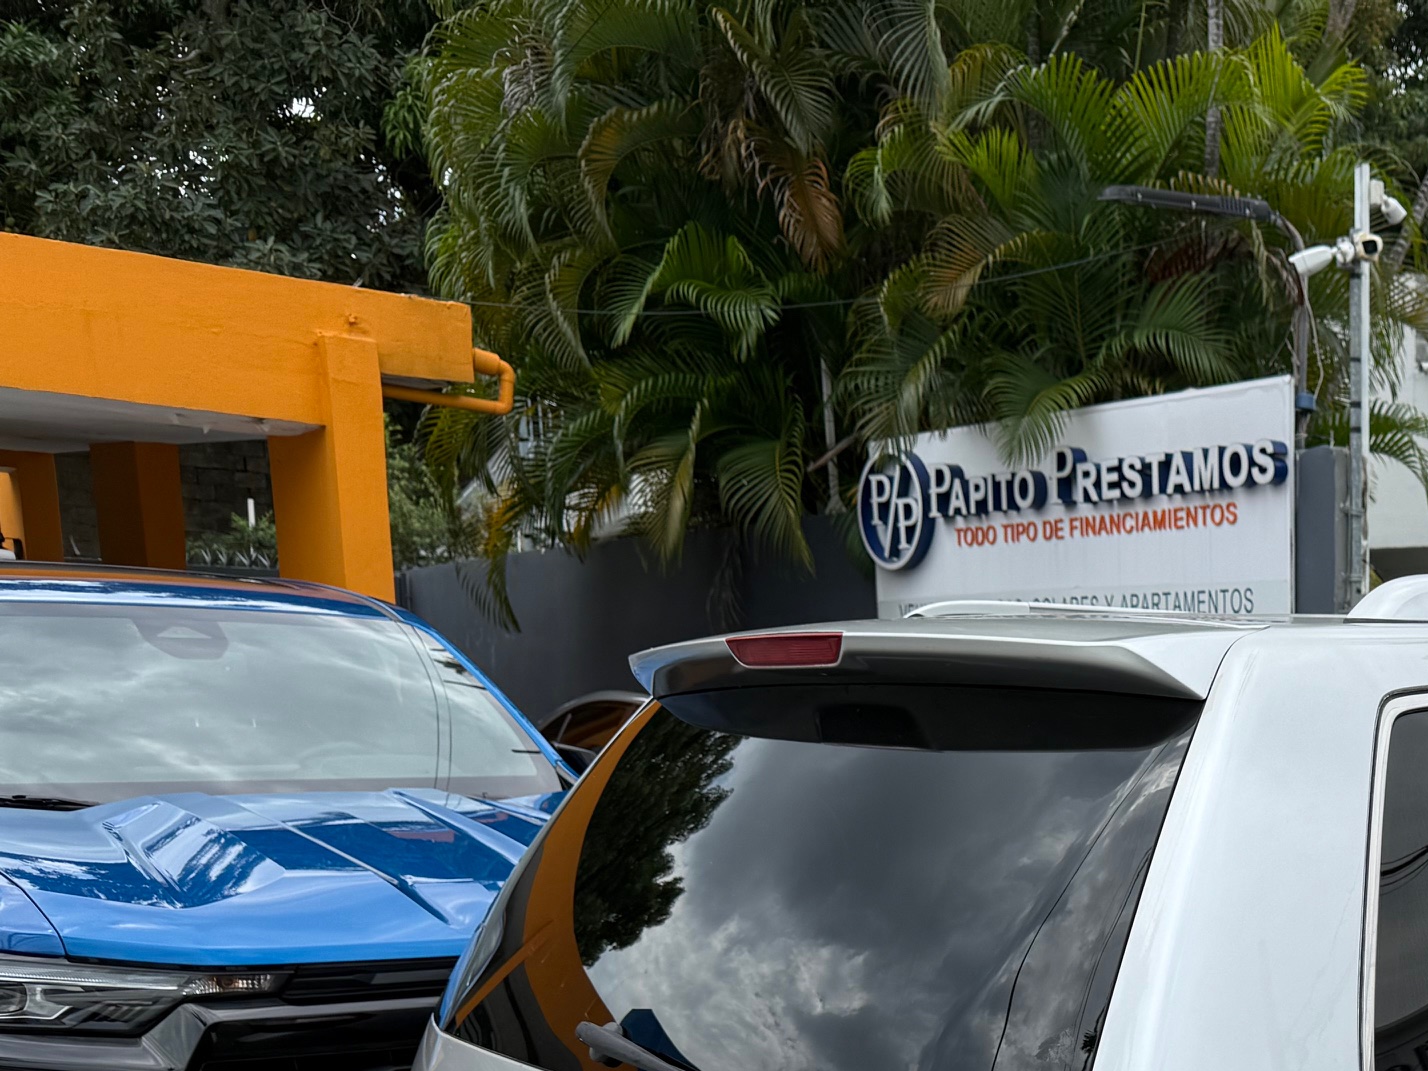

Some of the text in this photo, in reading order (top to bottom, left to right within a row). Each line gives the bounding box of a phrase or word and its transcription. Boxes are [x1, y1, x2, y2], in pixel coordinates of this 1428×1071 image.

[928, 439, 1280, 518] PAPITO PRESTAMOS
[955, 501, 1239, 548] TODO TIPO DE FINANCIAMIENTOS
[1120, 587, 1254, 614] APARTAMENTOS
